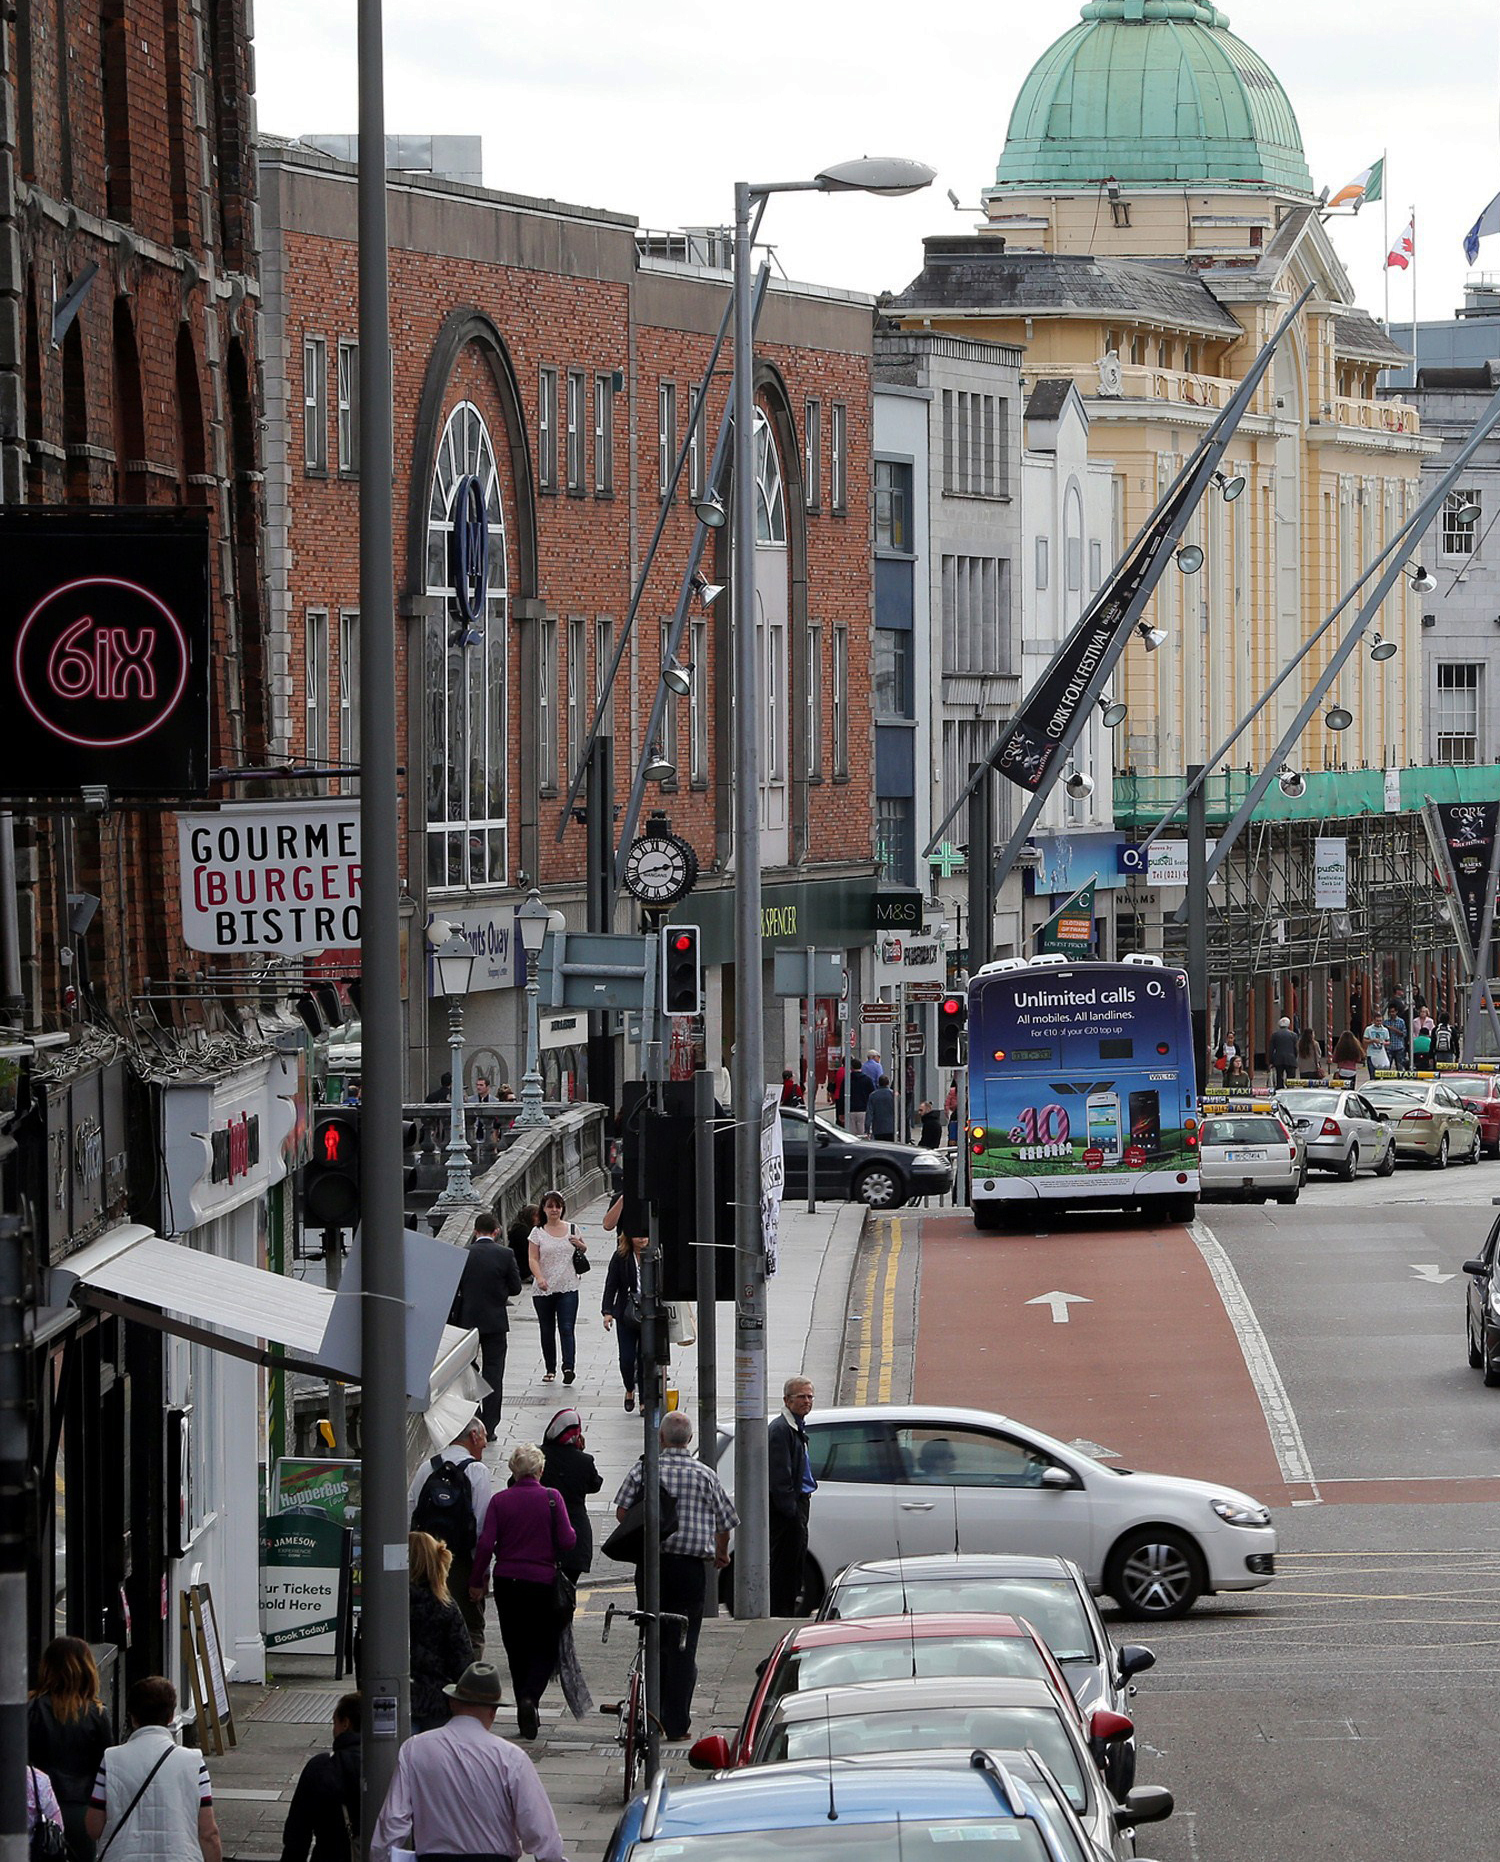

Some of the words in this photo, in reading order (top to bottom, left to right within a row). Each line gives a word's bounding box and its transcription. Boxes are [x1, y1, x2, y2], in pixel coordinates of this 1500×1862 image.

[1046, 705, 1068, 739] CORK
[1062, 674, 1088, 707] FOLK
[1076, 629, 1111, 680] FESTIVAL
[1000, 731, 1024, 769] CORK
[1450, 806, 1486, 818] CORK
[1153, 871, 1162, 879] Tel
[1164, 870, 1181, 880] (021)
[877, 903, 917, 921] M&S
[766, 905, 798, 938] SPENCER
[487, 920, 509, 963] Quay
[1014, 988, 1096, 1008] Unlimited
[1100, 986, 1136, 1004] calls
[1017, 1014, 1030, 1024] All
[1032, 1013, 1072, 1024] mobiles.
[1074, 1011, 1088, 1021] All
[1089, 1010, 1135, 1021] landlines.
[1031, 1029, 1042, 1037] For
[1043, 1028, 1057, 1037] €10
[1068, 1028, 1082, 1037] your
[1084, 1026, 1099, 1035] €20
[1100, 1027, 1111, 1036] top
[1112, 1026, 1123, 1035] up
[1231, 1087, 1250, 1095] TAXI
[1007, 1103, 1071, 1146] €10
[279, 1481, 350, 1508] HopperBus
[327, 1493, 346, 1507] Tour
[274, 1536, 317, 1548] JAMESON
[282, 1583, 332, 1596] Tickets
[289, 1600, 322, 1612] Here
[274, 1631, 299, 1644] Book
[299, 1622, 329, 1638] Today!
